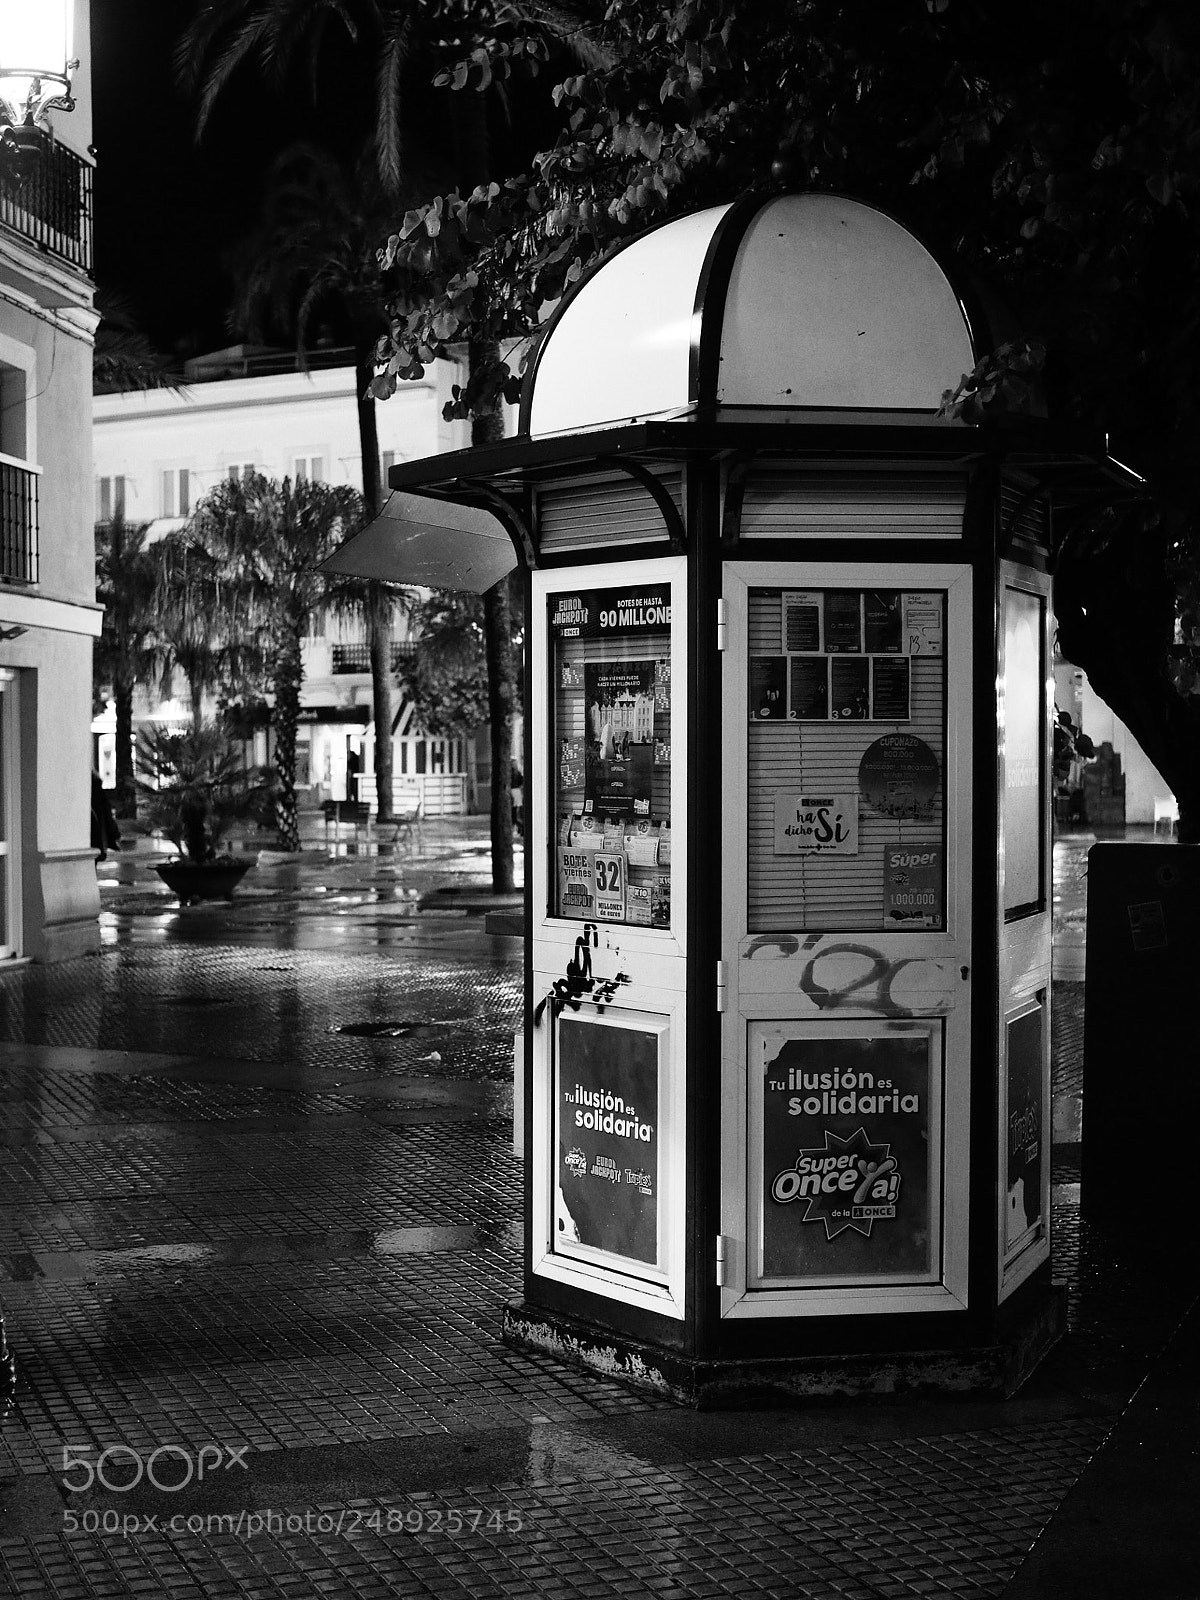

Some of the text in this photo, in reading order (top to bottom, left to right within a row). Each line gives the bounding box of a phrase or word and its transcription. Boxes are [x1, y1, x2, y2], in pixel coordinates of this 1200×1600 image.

[558, 598, 581, 612] EURO
[617, 597, 663, 608] BOTES DE HASTA
[552, 608, 588, 625] JACKPOT
[599, 609, 617, 628] 90
[789, 710, 797, 719] 2
[831, 710, 839, 719] 3
[796, 809, 817, 824] ha
[784, 824, 813, 837] dicho
[814, 807, 850, 843] Sí
[563, 854, 588, 868] BOTE
[889, 851, 937, 869] Súper
[563, 868, 592, 878] viernes
[595, 860, 620, 892] 32
[562, 893, 593, 907] JACKPOT
[889, 893, 935, 905] 1.000.000
[597, 902, 623, 911] MILLONES
[769, 1067, 893, 1091] Tu ilusión es
[564, 1083, 635, 1116] Tu ilusión es
[787, 1089, 919, 1116] solidaria
[574, 1109, 652, 1142] solidaria
[595, 1155, 616, 1169] EURO
[590, 1165, 621, 1183] JACKPOT
[831, 1207, 893, 1217] de la ONCE
